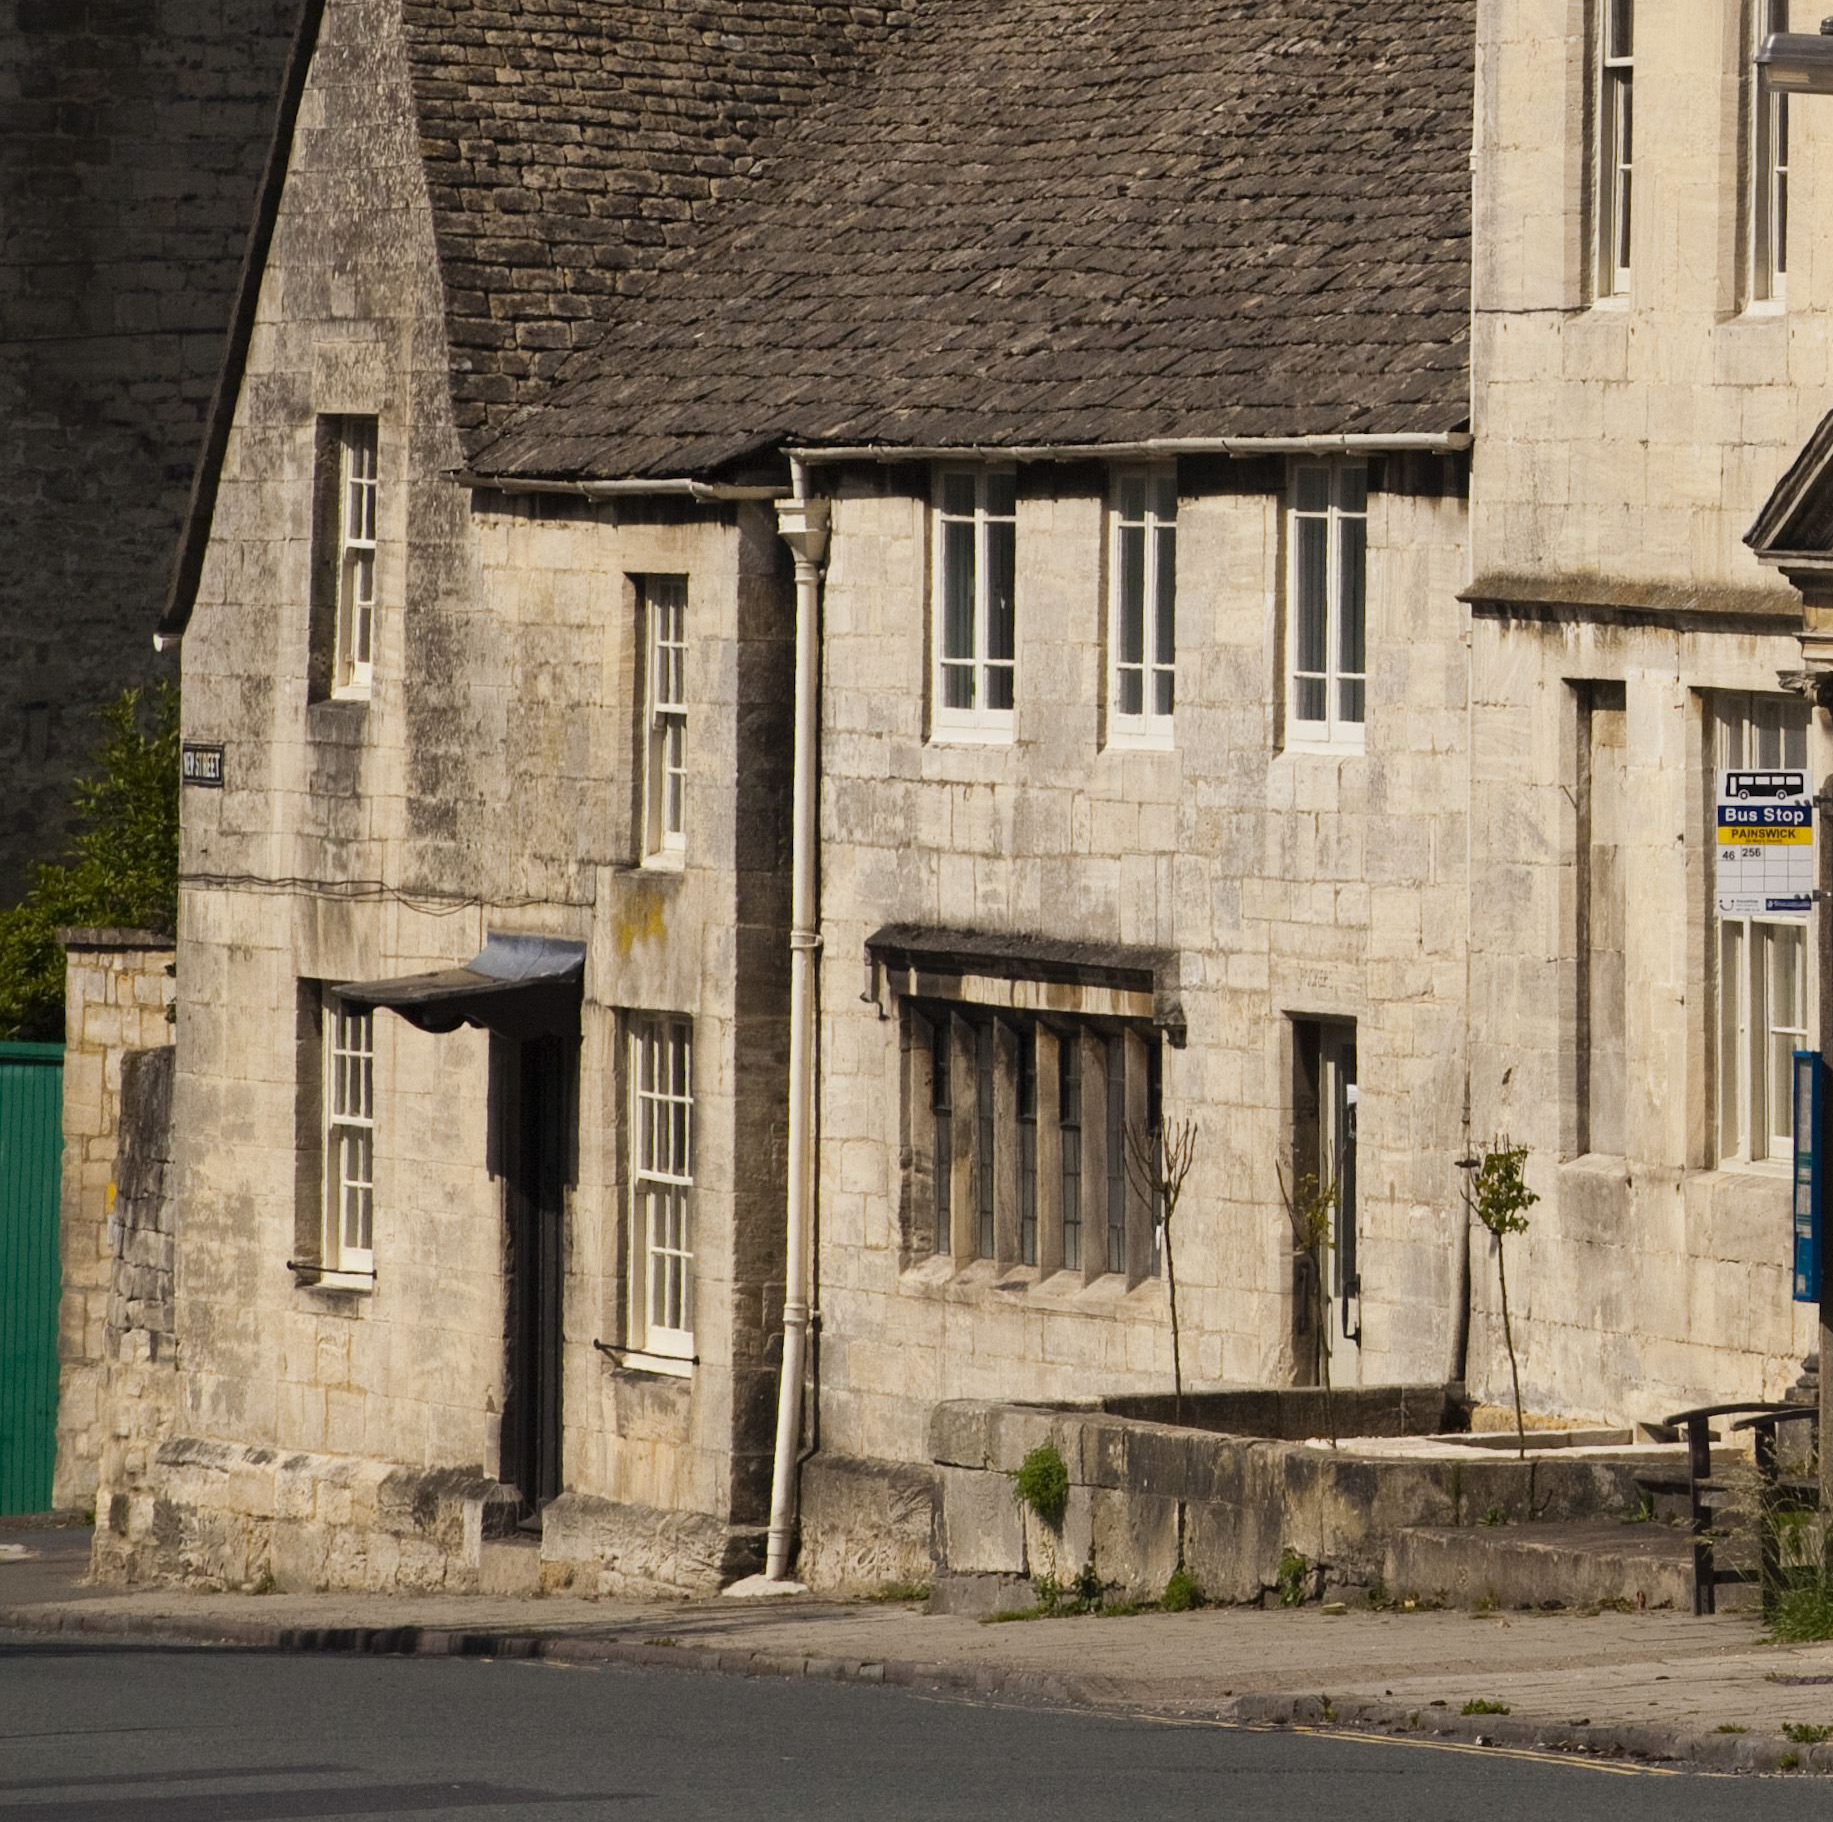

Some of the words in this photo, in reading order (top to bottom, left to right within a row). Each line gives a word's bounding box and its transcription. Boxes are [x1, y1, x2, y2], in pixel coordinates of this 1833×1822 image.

[195, 751, 220, 778] STREET
[1725, 808, 1758, 822] Bus
[1763, 807, 1804, 825] Stop
[1731, 829, 1796, 839] PAINSWICK
[1722, 851, 1735, 860] 46
[1742, 847, 1761, 858] 256
